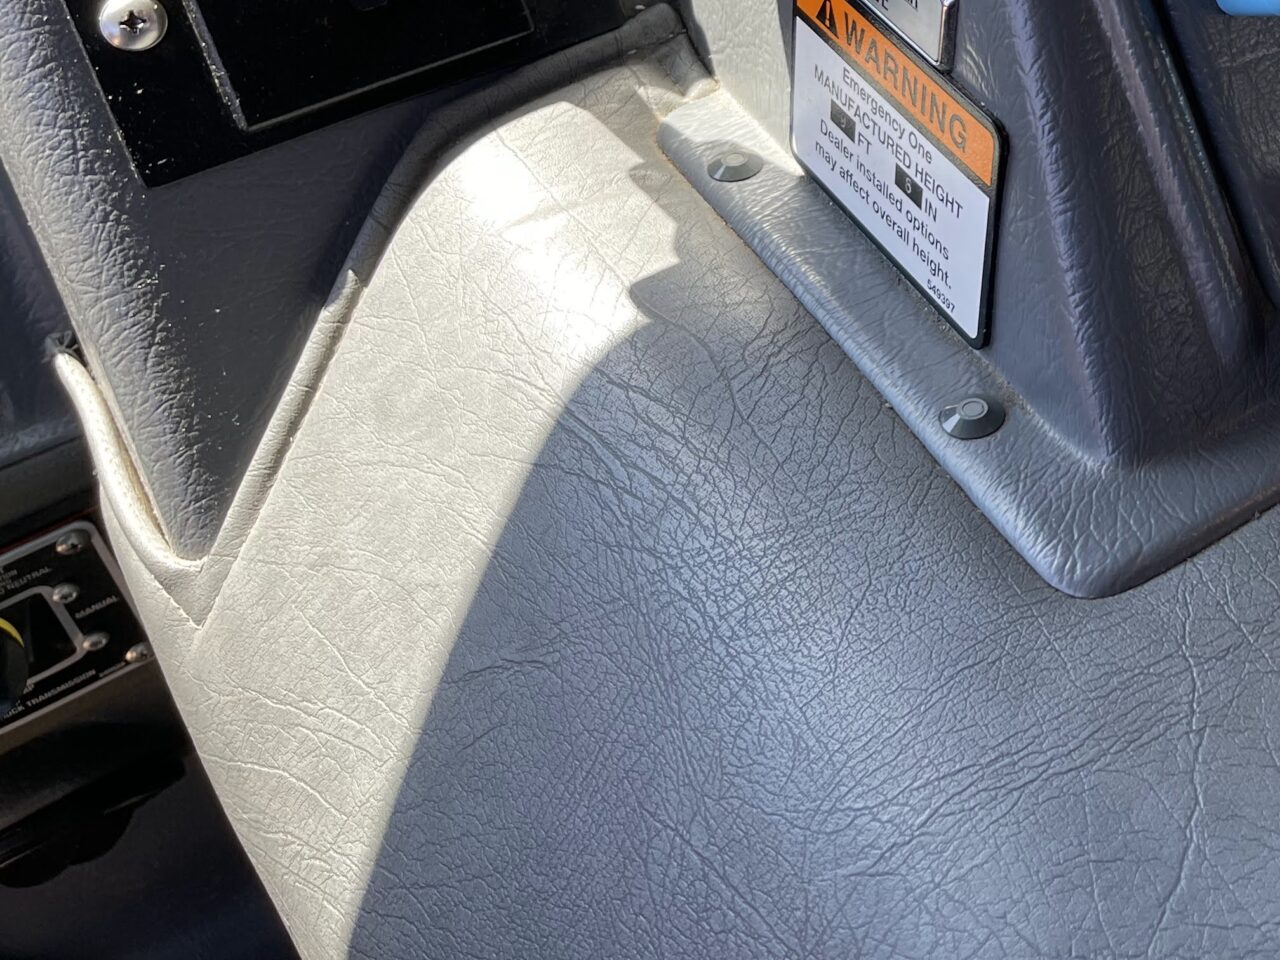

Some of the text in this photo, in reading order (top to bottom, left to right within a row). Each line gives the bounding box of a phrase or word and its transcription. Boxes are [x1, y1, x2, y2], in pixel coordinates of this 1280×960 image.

[842, 66, 932, 164] Emergency One
[844, 13, 965, 152] WARNING
[814, 63, 963, 218] MANUFACTURED HEIGHT
[820, 119, 948, 260] Dealer installed options
[857, 131, 872, 154] FT
[903, 176, 913, 194] 6
[924, 198, 937, 222] IN
[815, 141, 951, 289] may affect overall height.
[927, 278, 955, 312] 549397
[75, 595, 118, 620] MANUAL
[26, 668, 97, 707] TRANSMISSION
